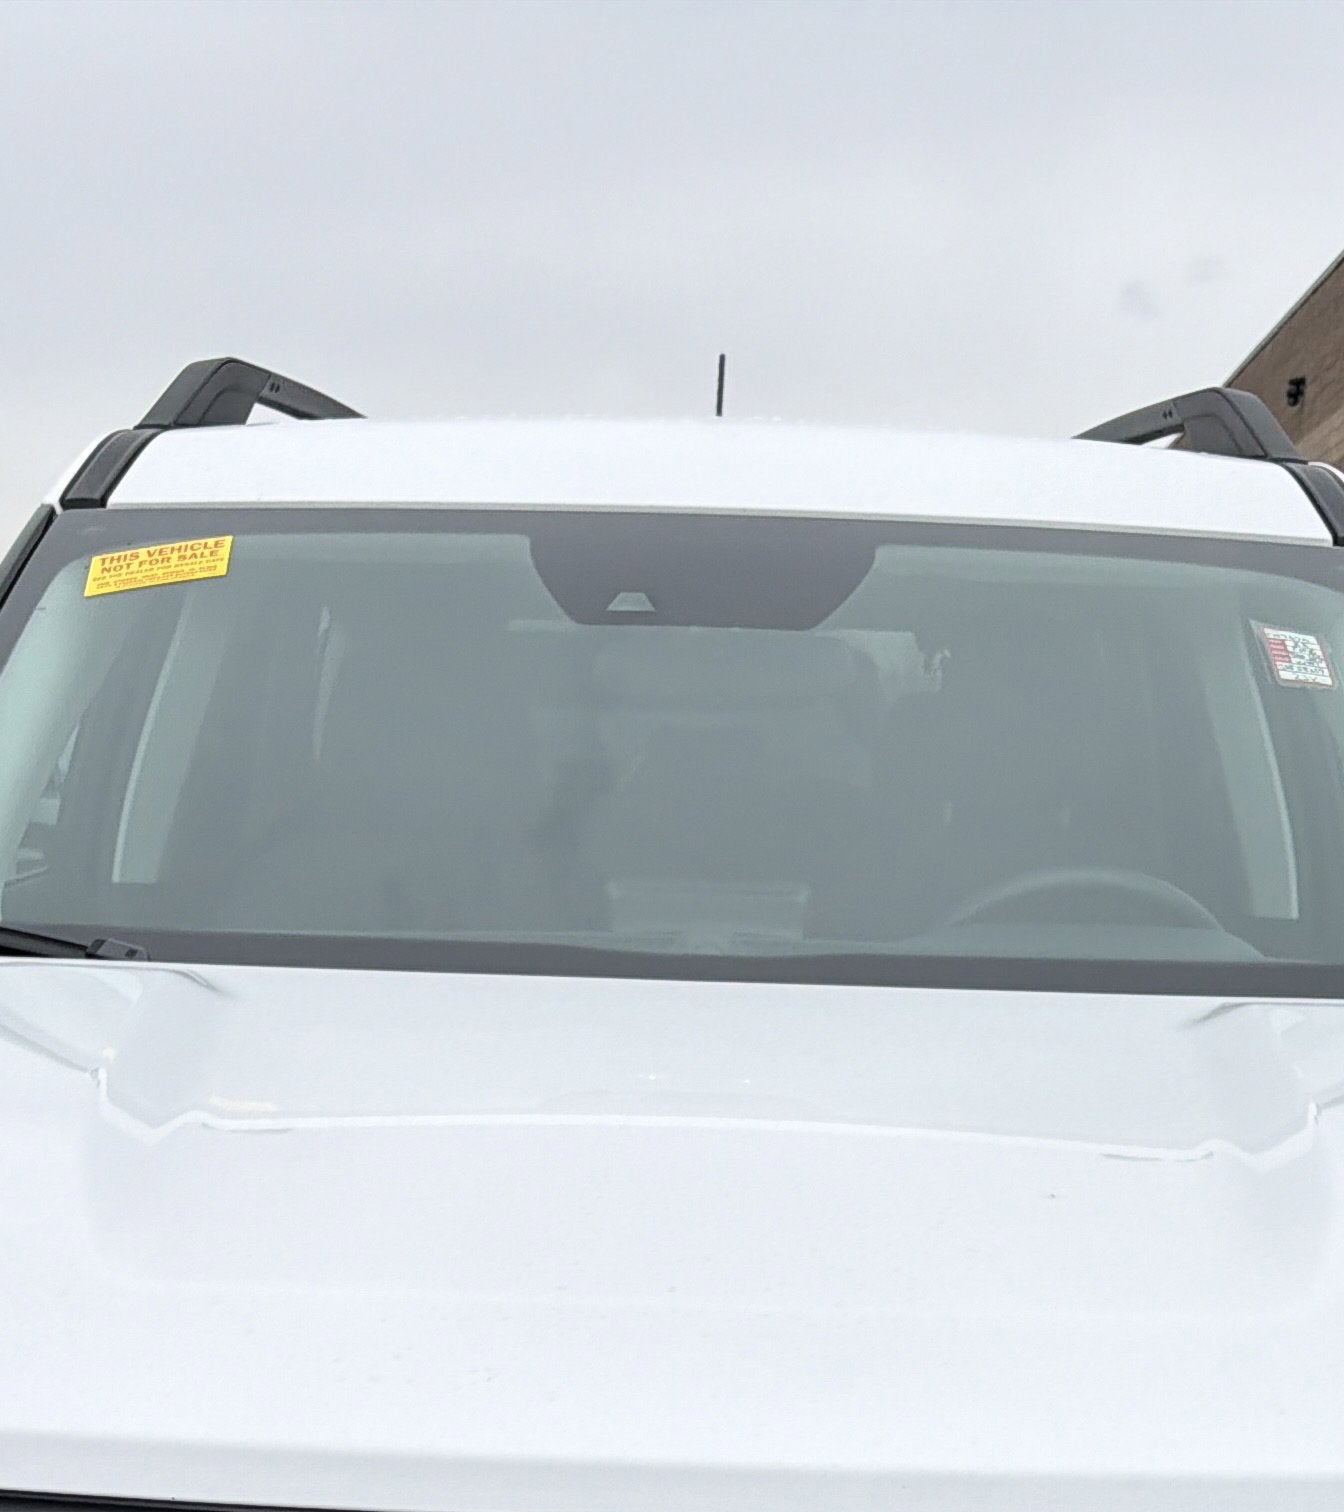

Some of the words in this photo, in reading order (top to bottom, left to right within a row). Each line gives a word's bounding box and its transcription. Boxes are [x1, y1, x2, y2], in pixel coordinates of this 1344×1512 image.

[99, 552, 140, 567] THIS
[146, 538, 226, 557] VEHICLE
[101, 562, 133, 575] NOT
[139, 556, 172, 567] FOR
[177, 549, 219, 561] SALE
